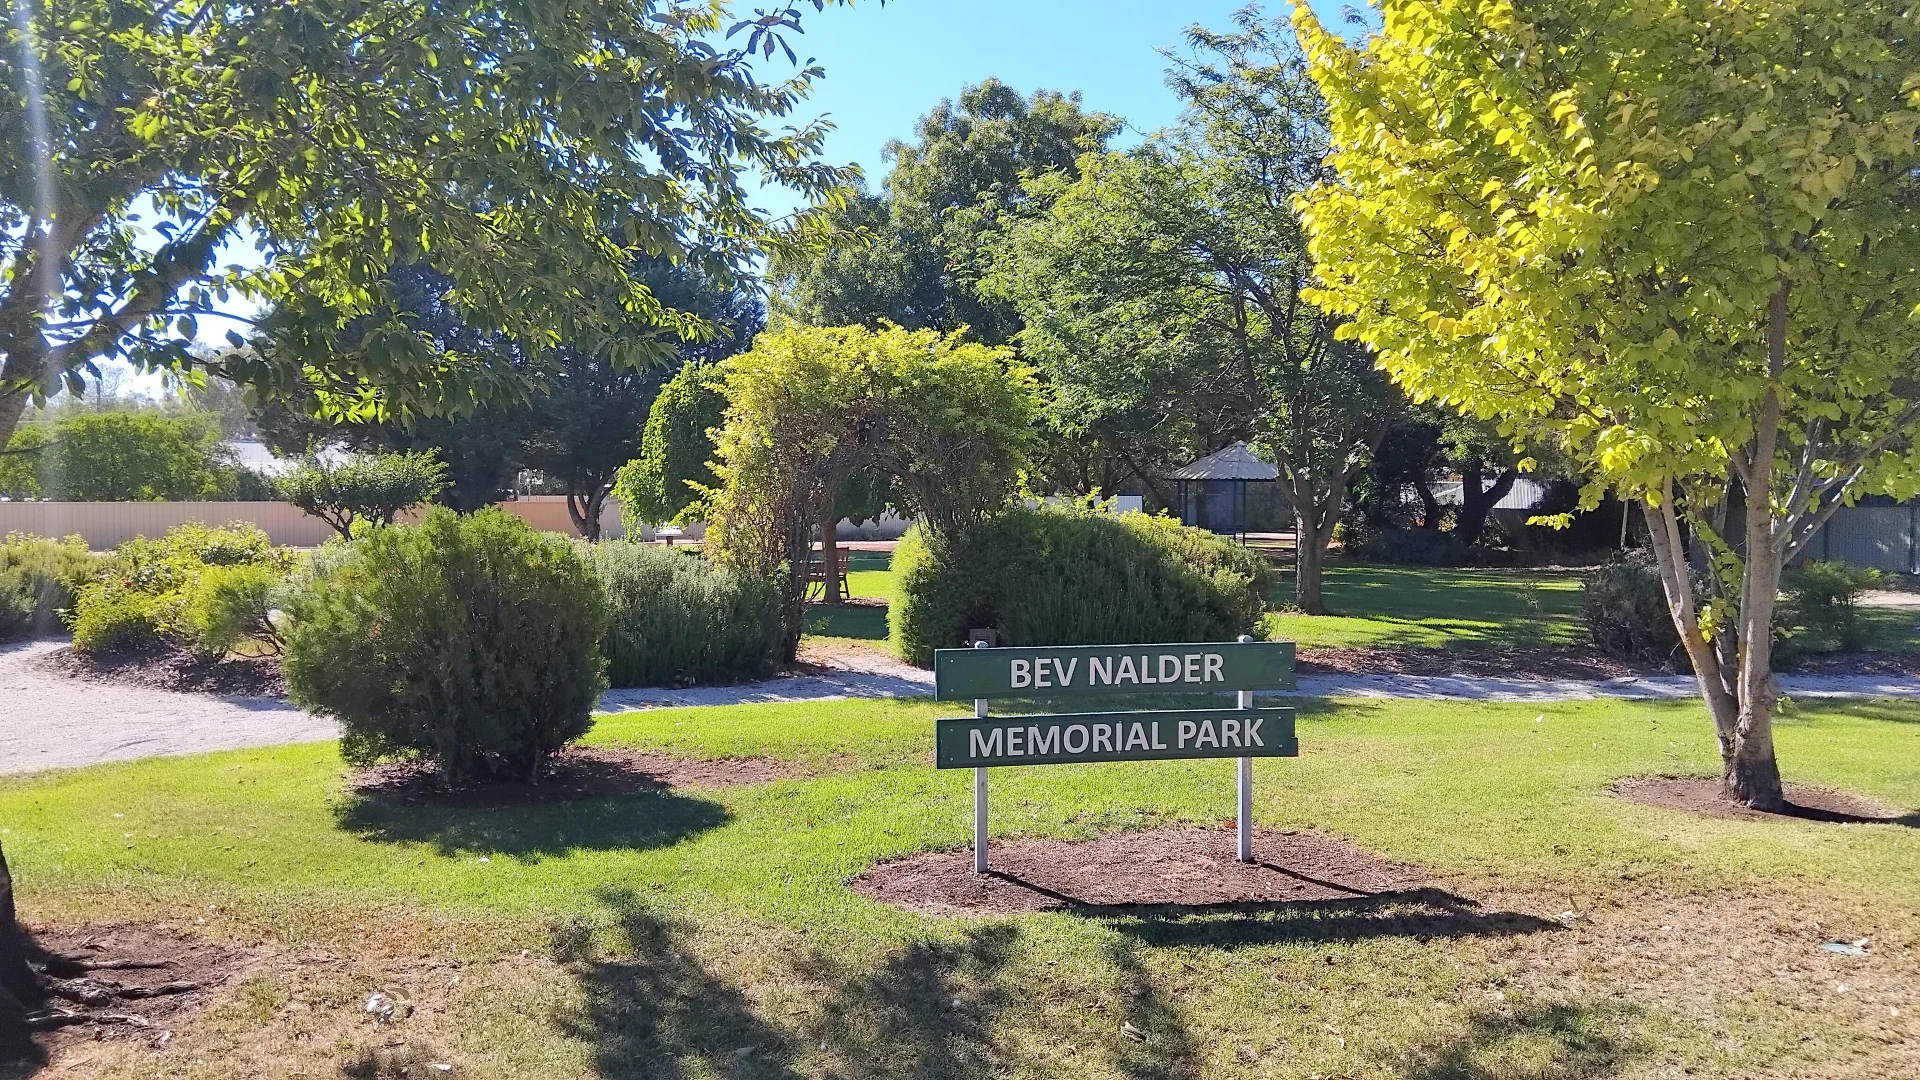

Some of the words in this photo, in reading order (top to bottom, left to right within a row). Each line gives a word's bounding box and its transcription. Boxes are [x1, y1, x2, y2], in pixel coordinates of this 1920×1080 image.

[1010, 656, 1078, 689] BEV
[1089, 653, 1225, 686] NALDER
[969, 721, 1167, 758] MEMORIAL
[1177, 718, 1265, 750] PARK
